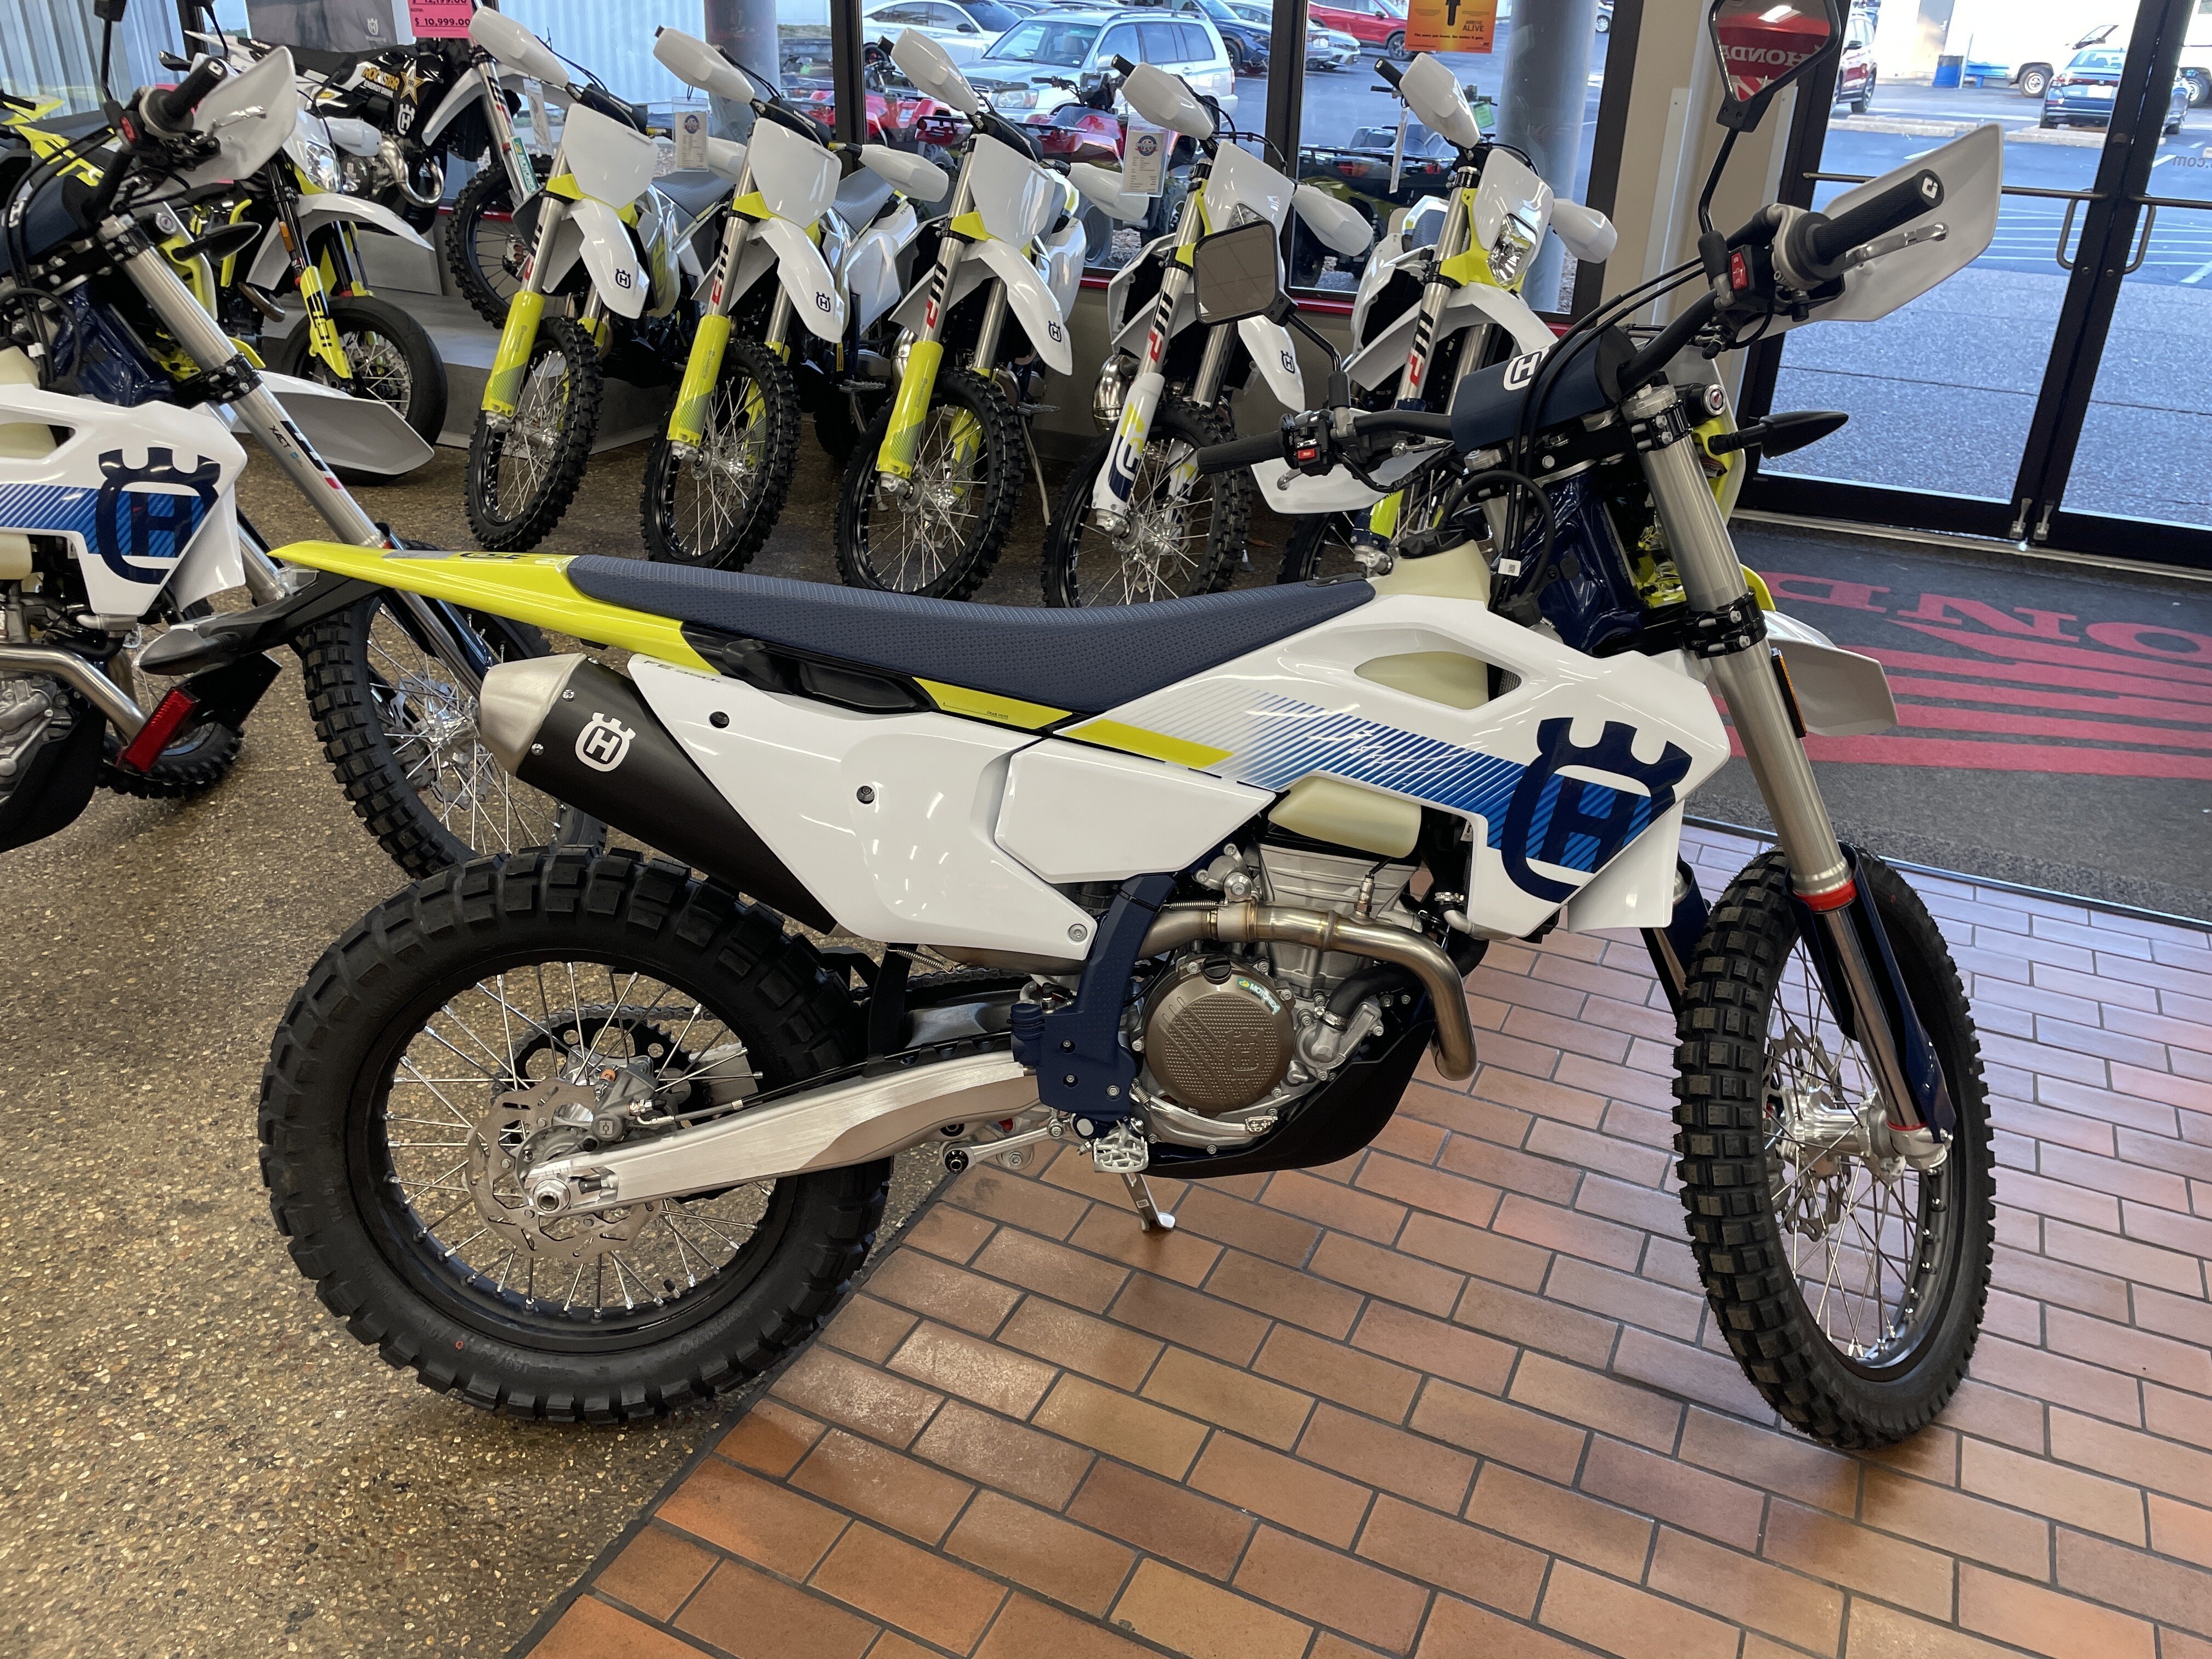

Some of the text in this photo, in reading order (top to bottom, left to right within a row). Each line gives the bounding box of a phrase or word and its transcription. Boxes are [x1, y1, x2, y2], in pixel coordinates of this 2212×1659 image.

[425, 18, 471, 26] 10,999.00
[268, 425, 291, 448] XACT
[1758, 571, 2212, 664] OND
[1249, 983, 1281, 1015] MOTOREX
